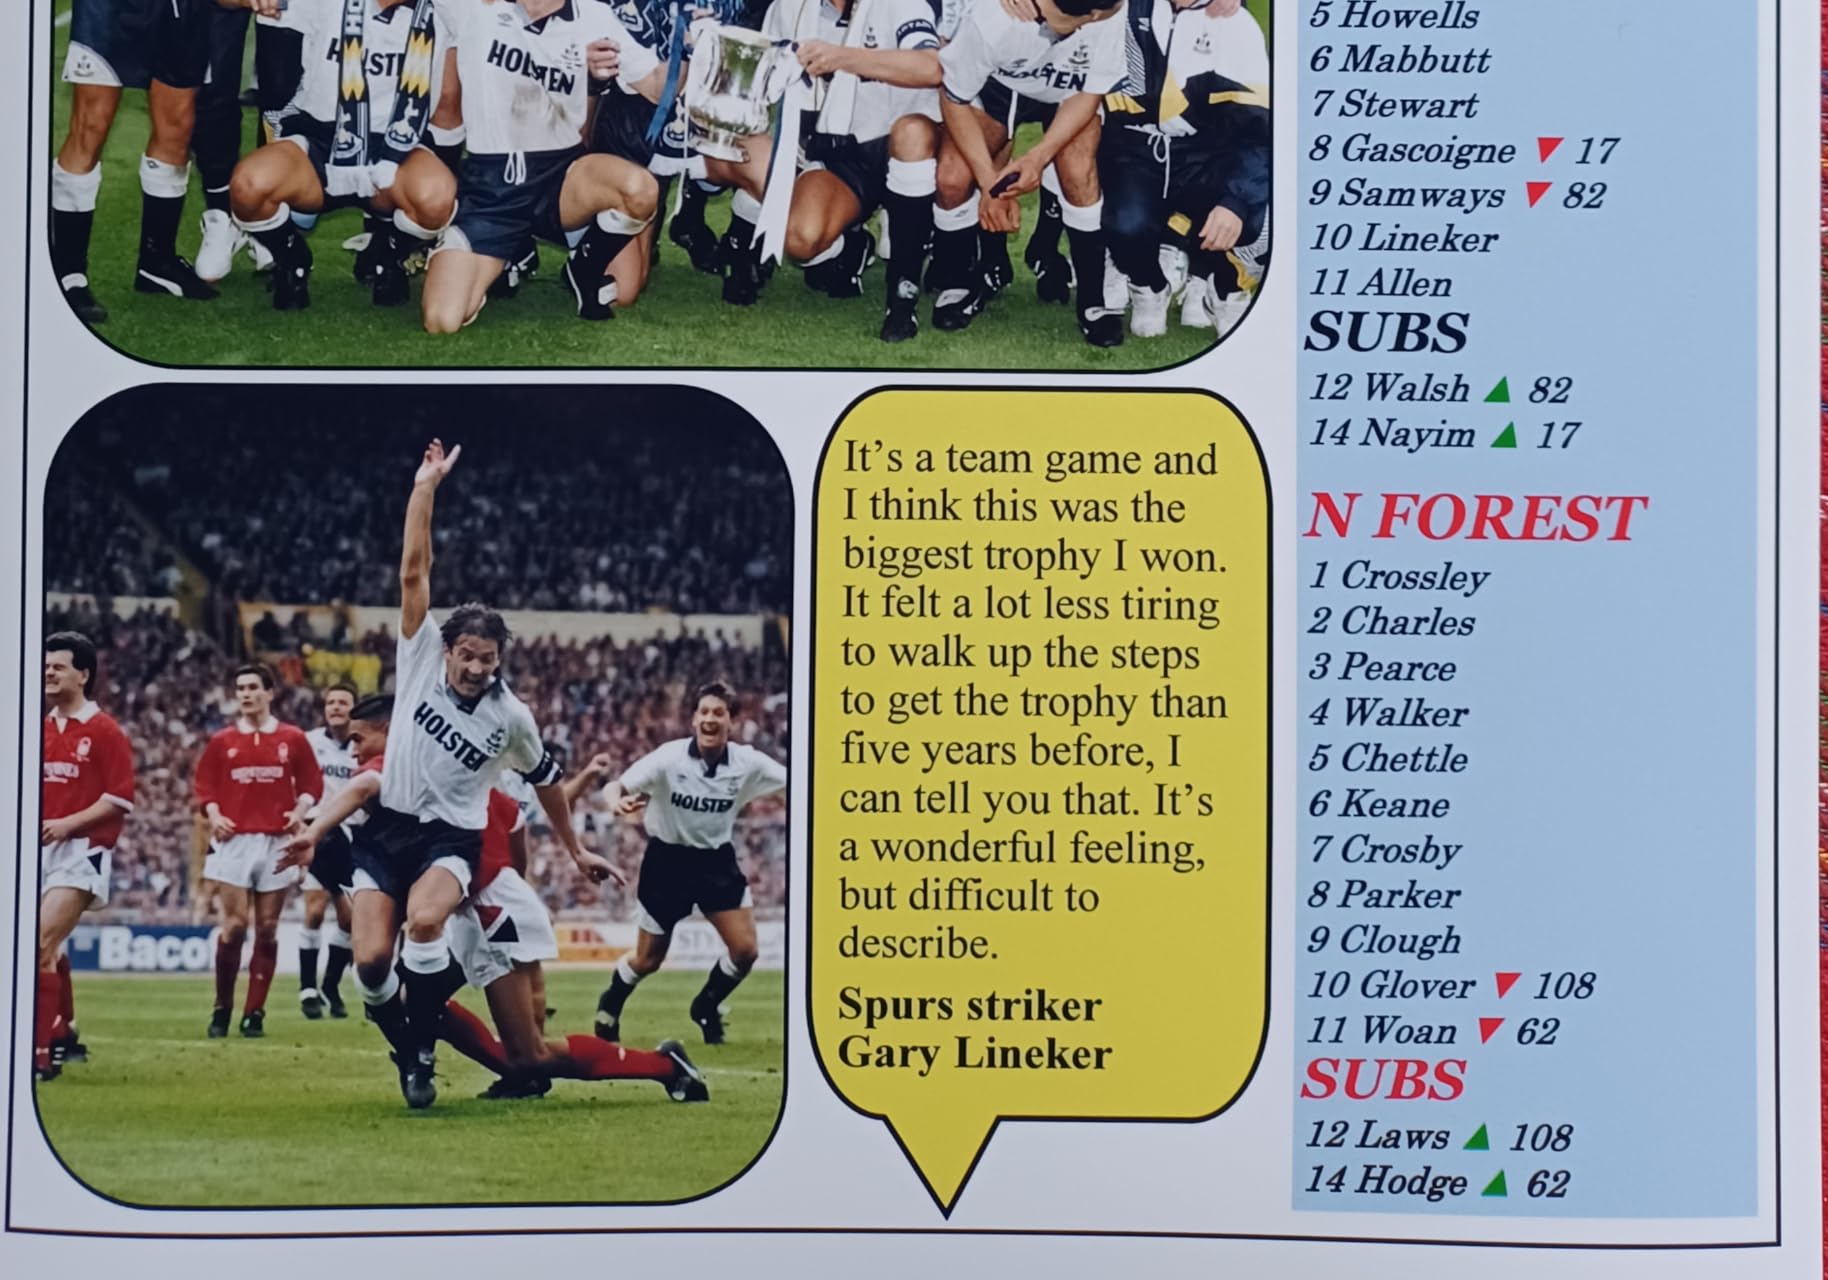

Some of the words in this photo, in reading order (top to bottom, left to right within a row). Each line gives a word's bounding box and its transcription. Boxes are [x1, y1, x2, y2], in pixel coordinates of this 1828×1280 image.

[1309, 0, 1334, 28] 5
[1338, 0, 1480, 29] Howells
[1310, 44, 1333, 72] 6
[1338, 44, 1492, 74] Mabbutt
[1314, 89, 1335, 117] 7
[1338, 88, 1480, 119] Stewart
[1308, 134, 1333, 162] 8
[1341, 132, 1517, 170] Gascoigne
[1575, 137, 1622, 165] 17
[1308, 178, 1332, 206] 9
[1337, 177, 1507, 215] Samways
[1562, 181, 1608, 209] 82
[1309, 223, 1353, 251] 10
[1358, 222, 1500, 253] Lineker
[1309, 268, 1349, 296] 11
[1356, 267, 1452, 297] Allen
[1303, 309, 1470, 354] SUBS
[1309, 372, 1353, 401] 12
[1366, 372, 1470, 403] Walsh
[1528, 376, 1573, 404] 82
[1309, 417, 1352, 446] 14
[1358, 417, 1476, 454] Nayim
[1536, 421, 1583, 449] 17
[844, 439, 903, 473] It’s
[915, 449, 935, 473] a
[946, 444, 1033, 473] team
[1045, 450, 1142, 483] game
[1154, 442, 1218, 476] and
[843, 487, 857, 520] I
[869, 486, 962, 521] think
[973, 487, 1038, 522] this
[1050, 499, 1119, 523] was
[1130, 489, 1186, 524] the
[1302, 492, 1363, 538] N
[1371, 493, 1649, 542] FOREST
[844, 535, 973, 579] biggest
[984, 537, 1101, 580] trophy
[1114, 539, 1126, 571] I
[1140, 548, 1226, 573] won.
[1309, 561, 1329, 589] 1
[1342, 559, 1492, 598] Crossley
[843, 585, 870, 618] It
[881, 583, 941, 618] felt
[953, 595, 973, 619] a
[985, 584, 1032, 619] lot
[1045, 585, 1110, 620] less
[1121, 586, 1220, 630] tiring
[1306, 606, 1333, 634] 2
[1342, 605, 1476, 637] Charles
[841, 637, 876, 667] to
[888, 633, 976, 667] walk
[988, 644, 1032, 677] up
[1044, 634, 1099, 669] the
[1111, 639, 1200, 679] steps
[1308, 652, 1332, 680] 3
[1337, 651, 1457, 682] Pearce
[840, 686, 875, 716] to
[887, 686, 943, 725] get
[953, 682, 1009, 717] the
[1020, 683, 1138, 727] trophy
[1150, 684, 1228, 719] than
[1308, 697, 1331, 726] 4
[1345, 696, 1470, 727] Walker
[841, 729, 910, 765] five
[921, 741, 1017, 774] years
[1029, 731, 1154, 774] before,
[1168, 734, 1181, 767] I
[1308, 743, 1332, 772] 5
[1341, 742, 1469, 773] Chettle
[840, 790, 902, 814] can
[913, 780, 970, 814] tell
[982, 791, 1051, 824] you
[1062, 781, 1139, 816] that.
[1155, 783, 1214, 817] It’s
[1309, 789, 1332, 817] 6
[1337, 788, 1450, 818] Keane
[839, 838, 859, 862] a
[870, 828, 1056, 864] wonderful
[1069, 829, 1205, 874] feeling,
[1313, 835, 1334, 863] 7
[1341, 833, 1464, 871] Crosby
[839, 876, 897, 911] but
[908, 877, 1053, 912] difficult
[1065, 883, 1100, 913] to
[1307, 880, 1331, 908] 8
[1336, 879, 1462, 909] Parker
[838, 924, 998, 960] describe.
[1307, 925, 1331, 953] 9
[1340, 924, 1461, 961] Clough
[1307, 970, 1351, 999] 10
[1360, 969, 1477, 1000] Glover
[1533, 971, 1597, 1000] 108
[838, 986, 953, 1030] Spurs
[967, 988, 1103, 1022] striker
[1306, 1015, 1347, 1044] 11
[1364, 1014, 1457, 1045] Woan
[1516, 1017, 1561, 1046] 62
[838, 1034, 941, 1078] Gary
[954, 1035, 1113, 1070] Lineker
[1300, 1057, 1467, 1101] SUBS
[1305, 1119, 1350, 1148] 12
[1354, 1119, 1451, 1151] Laws
[1509, 1123, 1575, 1153] 108
[1304, 1164, 1348, 1193] 14
[1353, 1164, 1468, 1203] Hodge
[1527, 1169, 1572, 1199] 62
